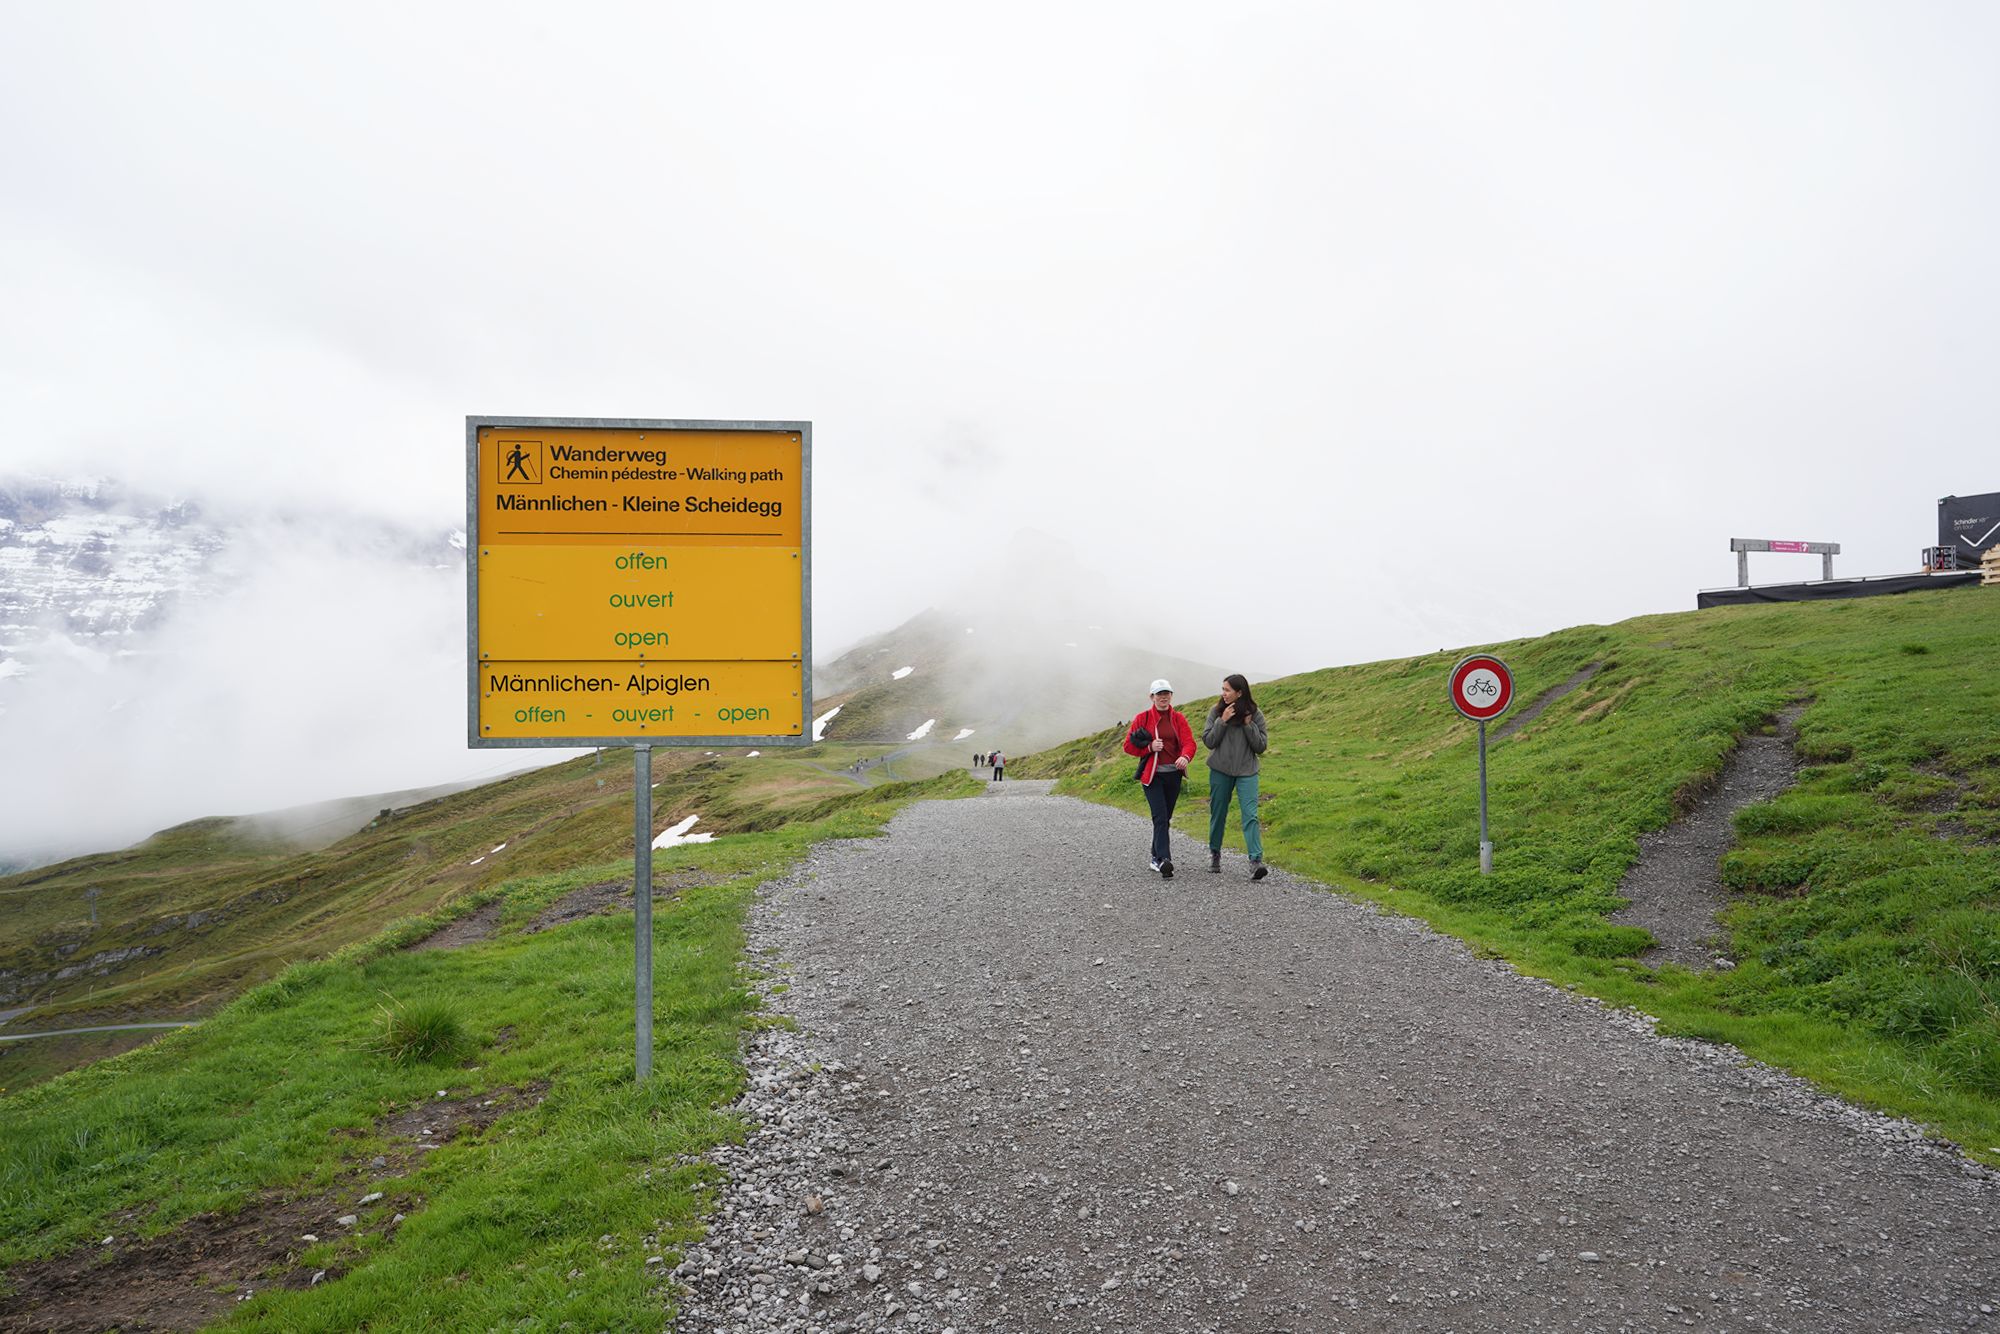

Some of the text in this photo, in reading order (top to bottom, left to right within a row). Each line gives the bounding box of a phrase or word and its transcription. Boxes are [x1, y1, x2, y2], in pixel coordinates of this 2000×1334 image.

[550, 445, 667, 466] Wanderweg
[549, 466, 608, 480] Chemin
[611, 466, 678, 482] pédestre
[686, 467, 747, 484] Walking
[750, 468, 784, 484] path
[496, 494, 608, 512] Männlichen
[622, 495, 680, 513] Kleine
[684, 495, 783, 518] Scheidegg
[615, 553, 668, 570] offen
[609, 591, 674, 608] ouvert
[614, 632, 669, 649] open
[626, 674, 710, 695] Alpiglen
[514, 705, 566, 723] offen
[611, 705, 675, 722] ouvert
[717, 704, 770, 725] open
